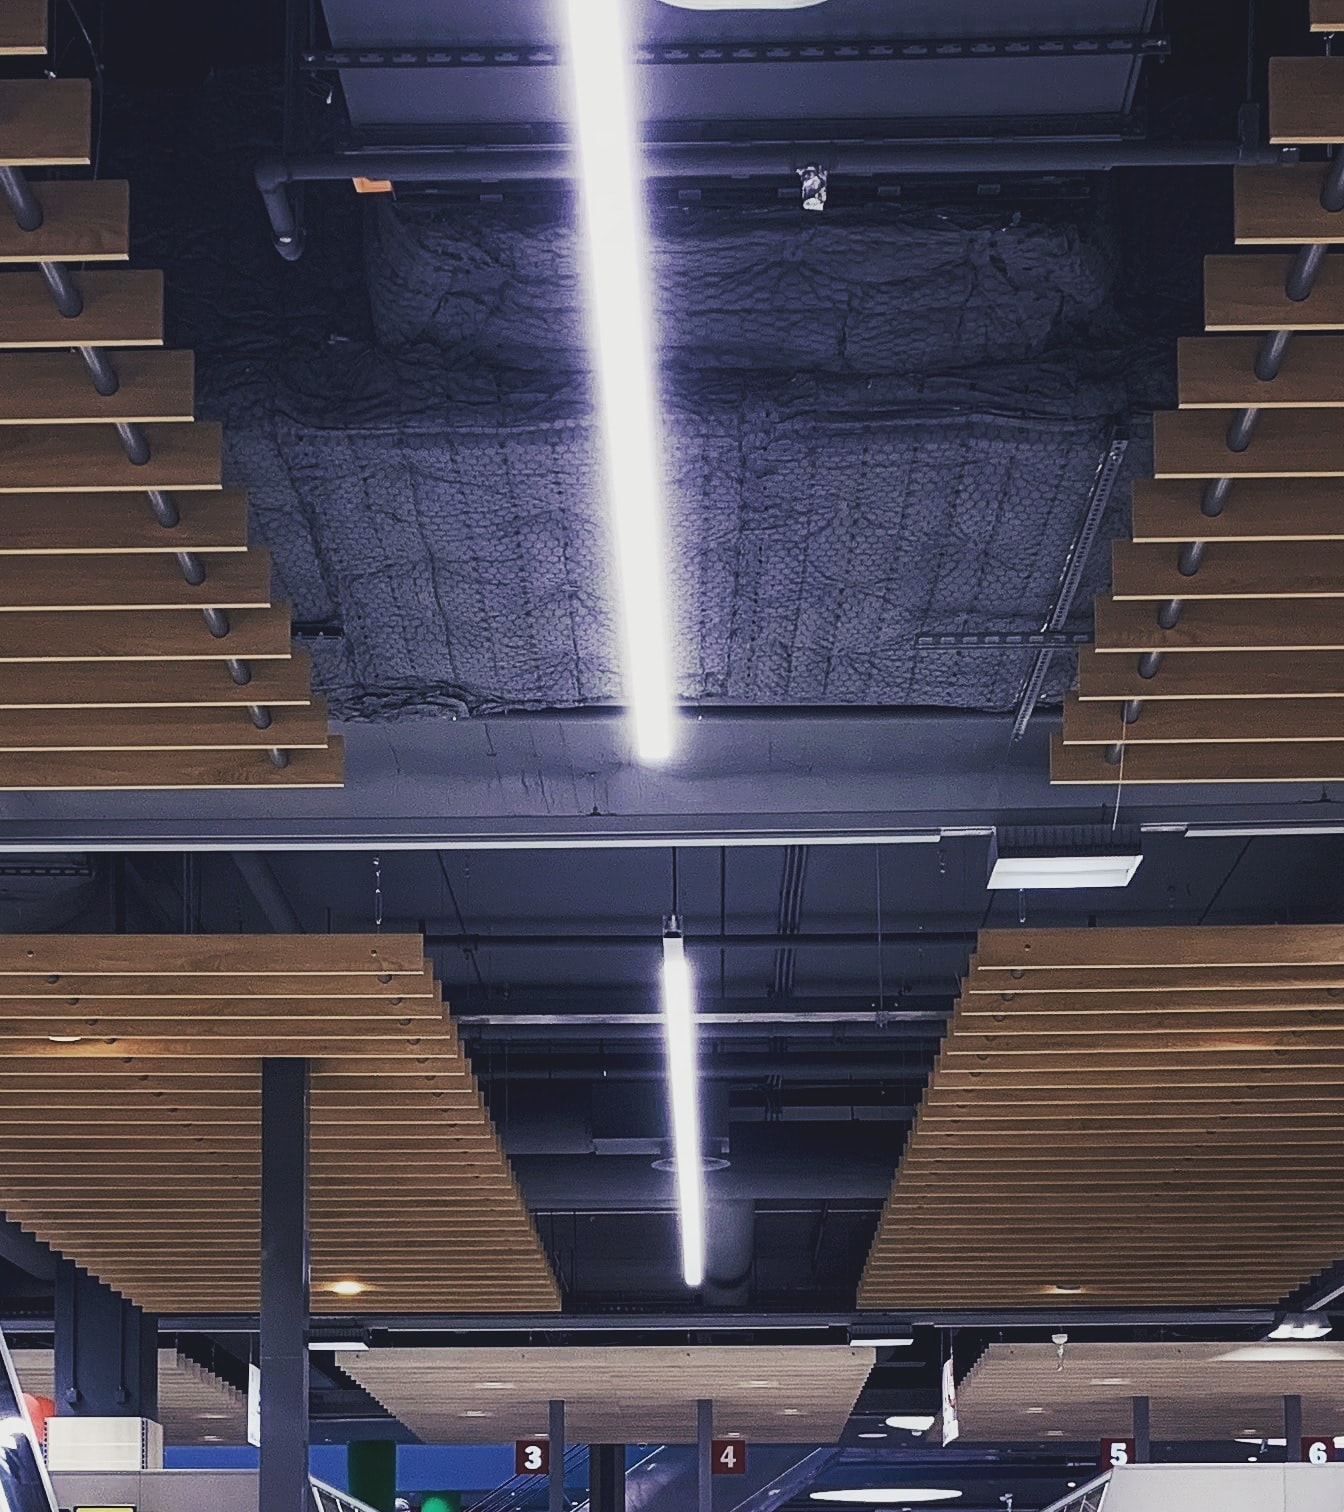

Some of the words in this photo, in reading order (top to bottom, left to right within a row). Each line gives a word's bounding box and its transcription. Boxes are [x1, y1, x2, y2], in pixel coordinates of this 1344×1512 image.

[524, 1446, 542, 1469] 3
[720, 1446, 737, 1468] 4
[1109, 1442, 1128, 1466] 5
[1309, 1442, 1327, 1464] 6
